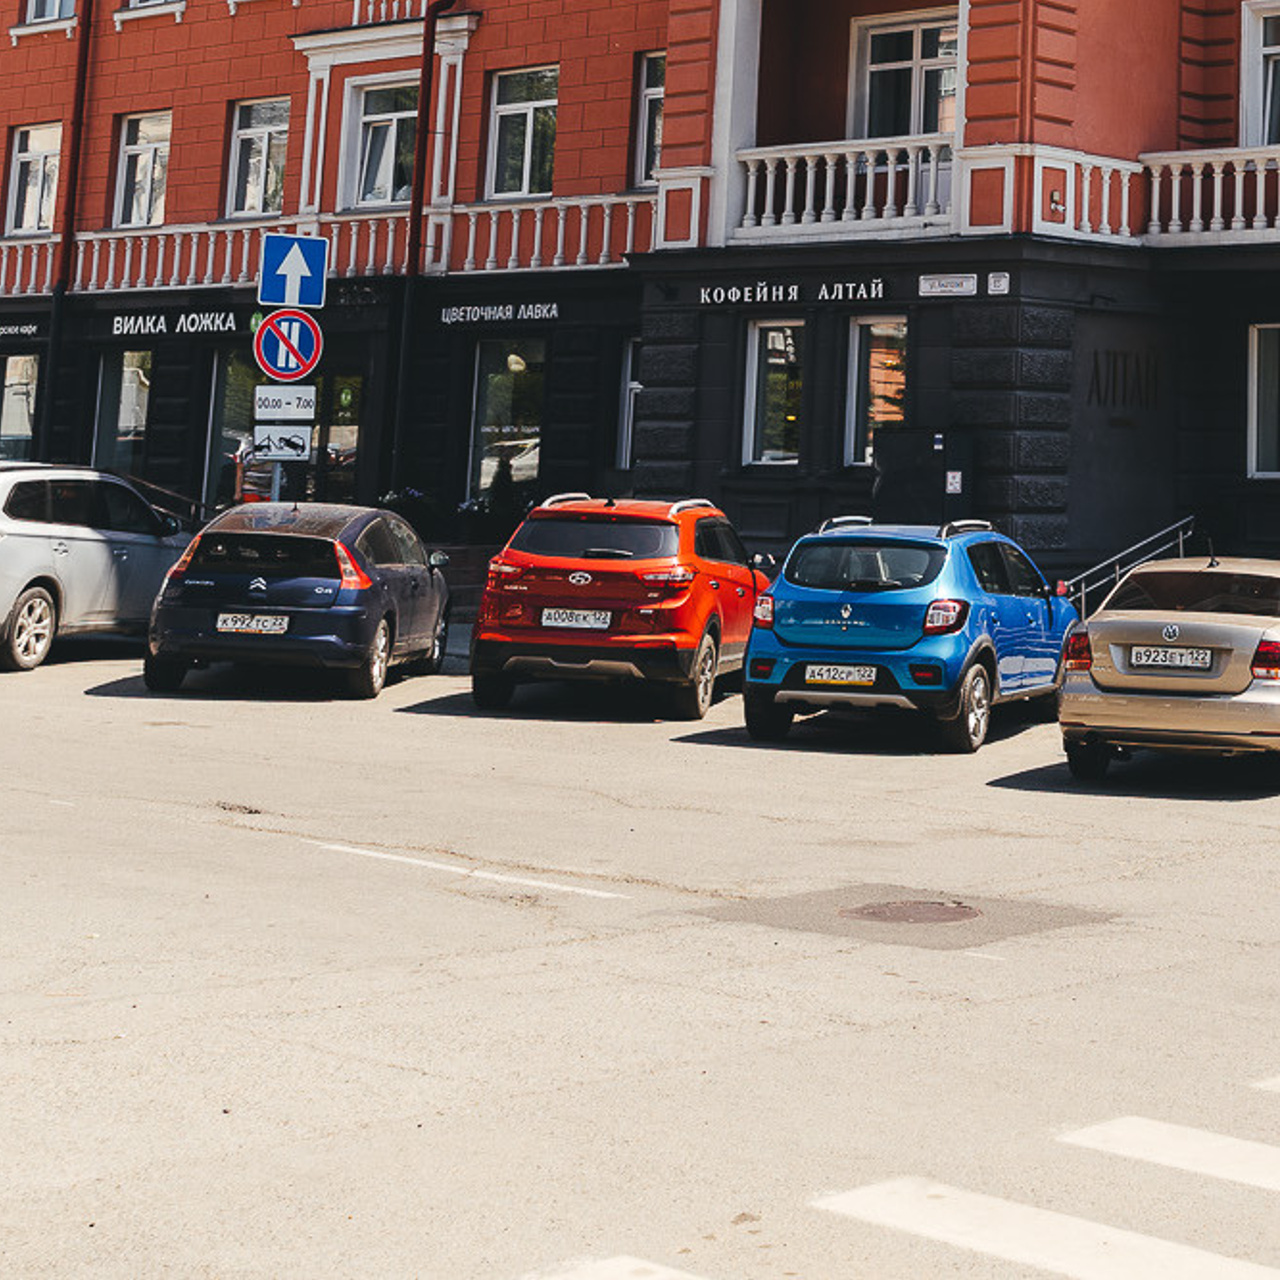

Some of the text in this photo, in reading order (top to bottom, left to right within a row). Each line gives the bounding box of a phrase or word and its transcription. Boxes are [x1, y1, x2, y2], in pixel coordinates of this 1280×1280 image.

[700, 279, 884, 304] КОФЕЙНЯ АЛТАЙ
[112, 312, 236, 335] ВИЛКА ЛОЖКА
[442, 303, 558, 324] ЦВЕТОЧНАЯ ЛАВКА
